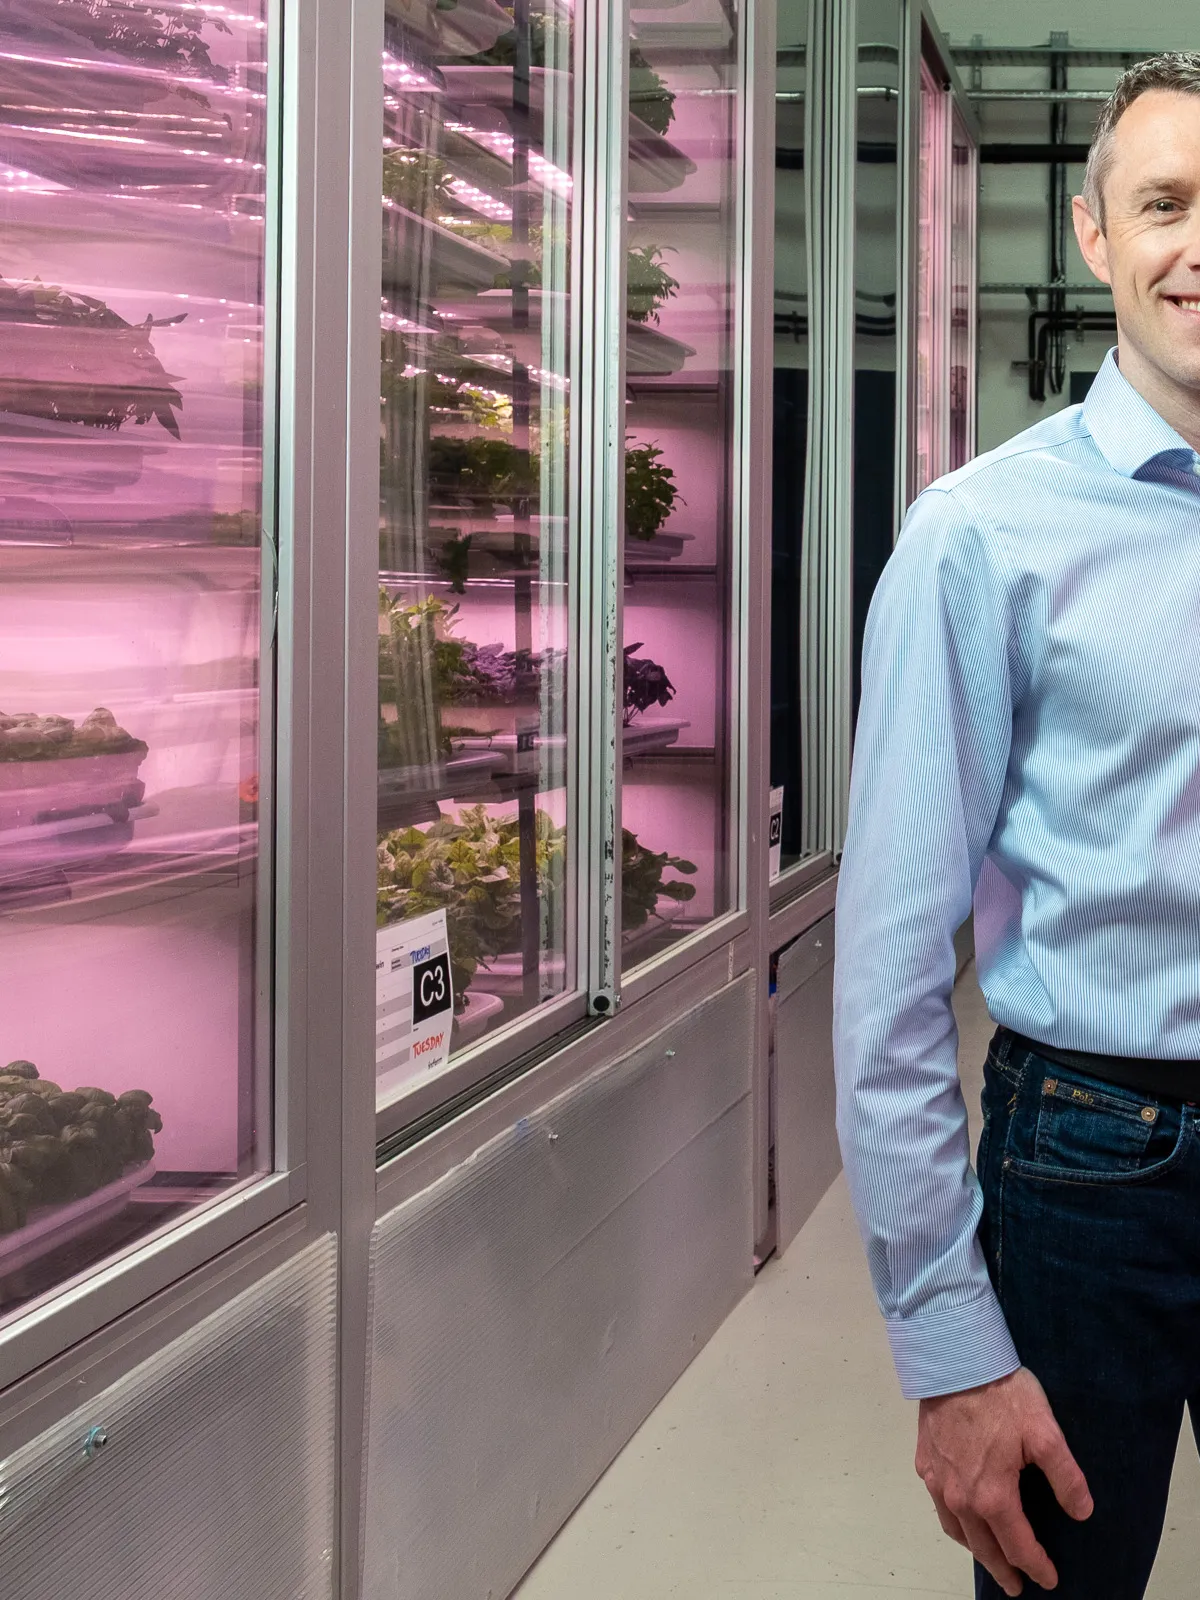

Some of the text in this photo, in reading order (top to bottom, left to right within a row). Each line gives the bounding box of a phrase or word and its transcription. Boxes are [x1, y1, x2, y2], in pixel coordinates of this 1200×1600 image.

[771, 817, 779, 840] C2
[421, 965, 445, 1007] C3
[413, 1032, 444, 1059] TUESDAY
[1072, 1089, 1094, 1104] Polo
